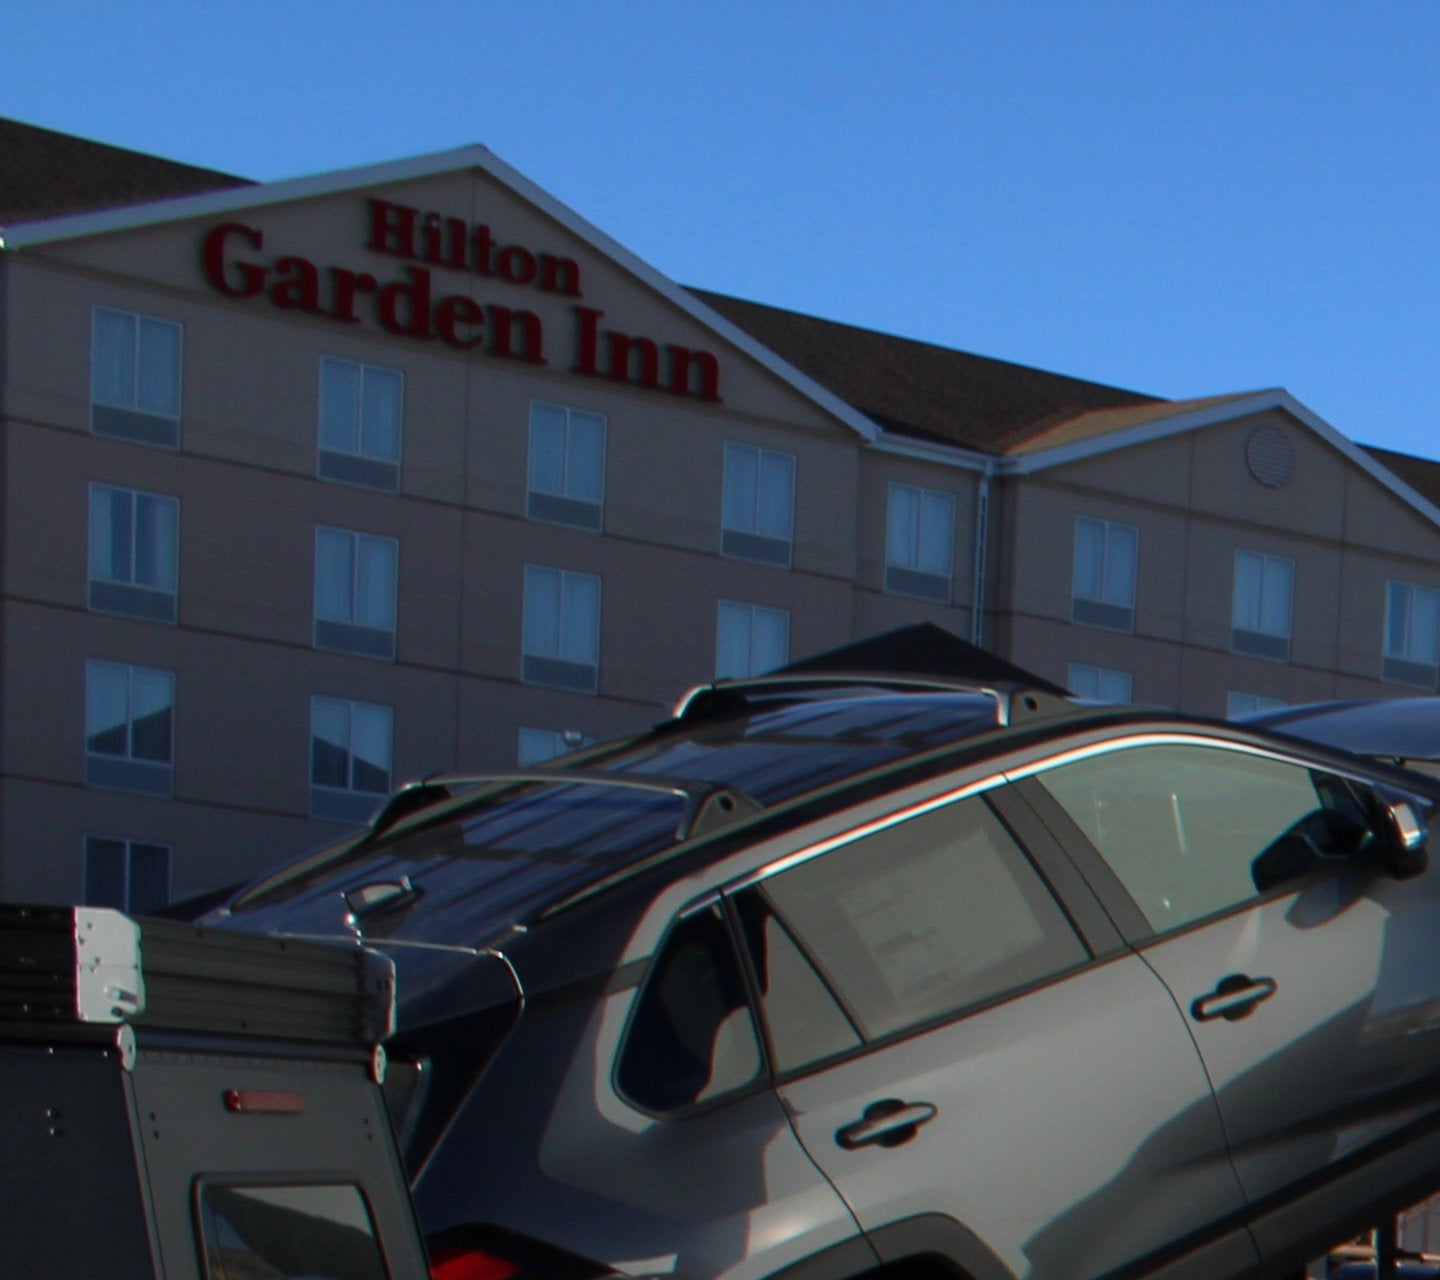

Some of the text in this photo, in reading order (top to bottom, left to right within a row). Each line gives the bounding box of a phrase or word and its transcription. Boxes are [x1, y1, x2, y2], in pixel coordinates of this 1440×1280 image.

[203, 221, 725, 404] Garden Inn
[366, 198, 583, 298] Hilton
